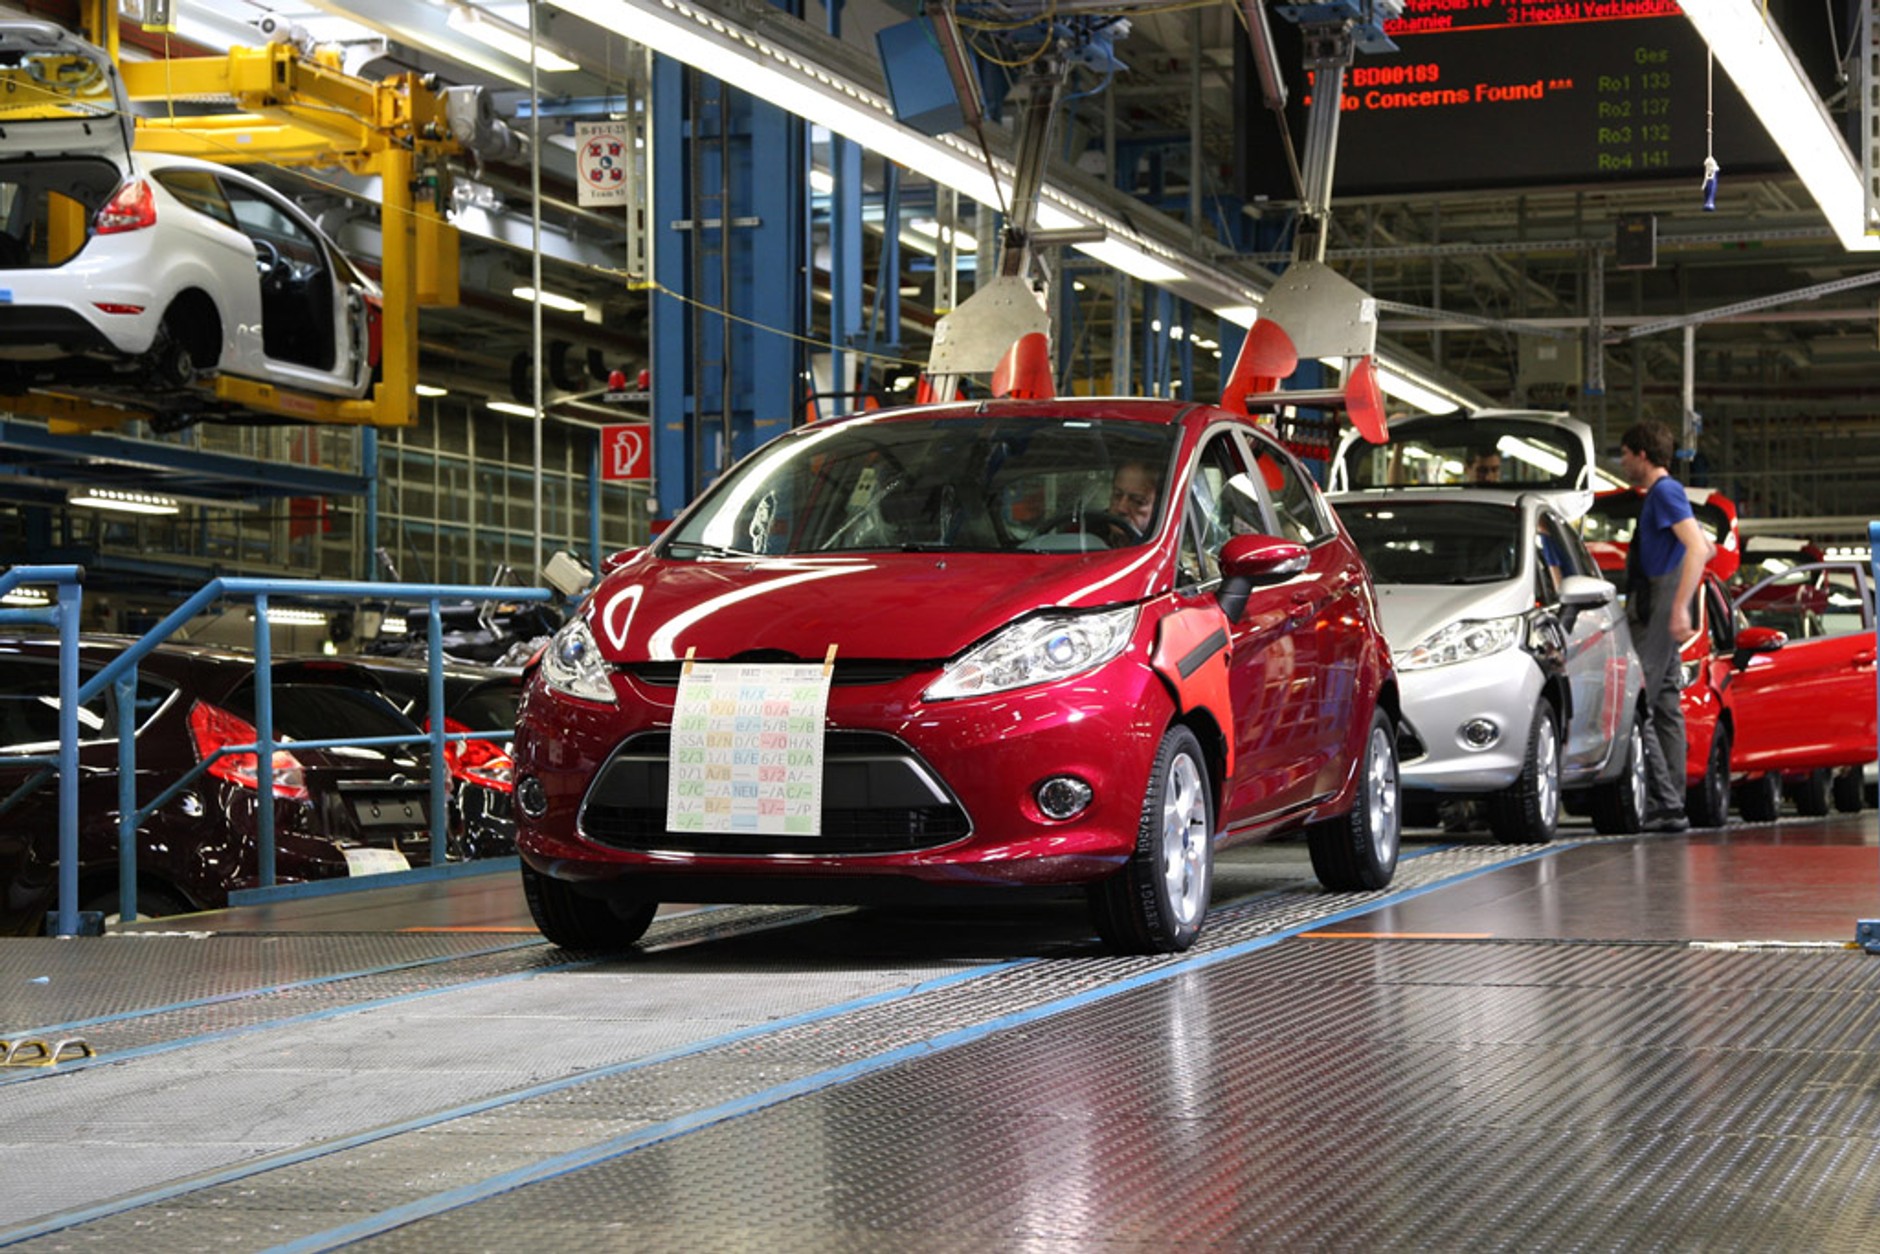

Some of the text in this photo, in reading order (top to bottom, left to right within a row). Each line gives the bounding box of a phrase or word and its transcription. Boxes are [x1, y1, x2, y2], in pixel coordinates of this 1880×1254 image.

[1353, 64, 1439, 87] BD00189
[1641, 72, 1671, 90] 133
[1365, 89, 1470, 110] Concerns
[1475, 82, 1544, 102] Found
